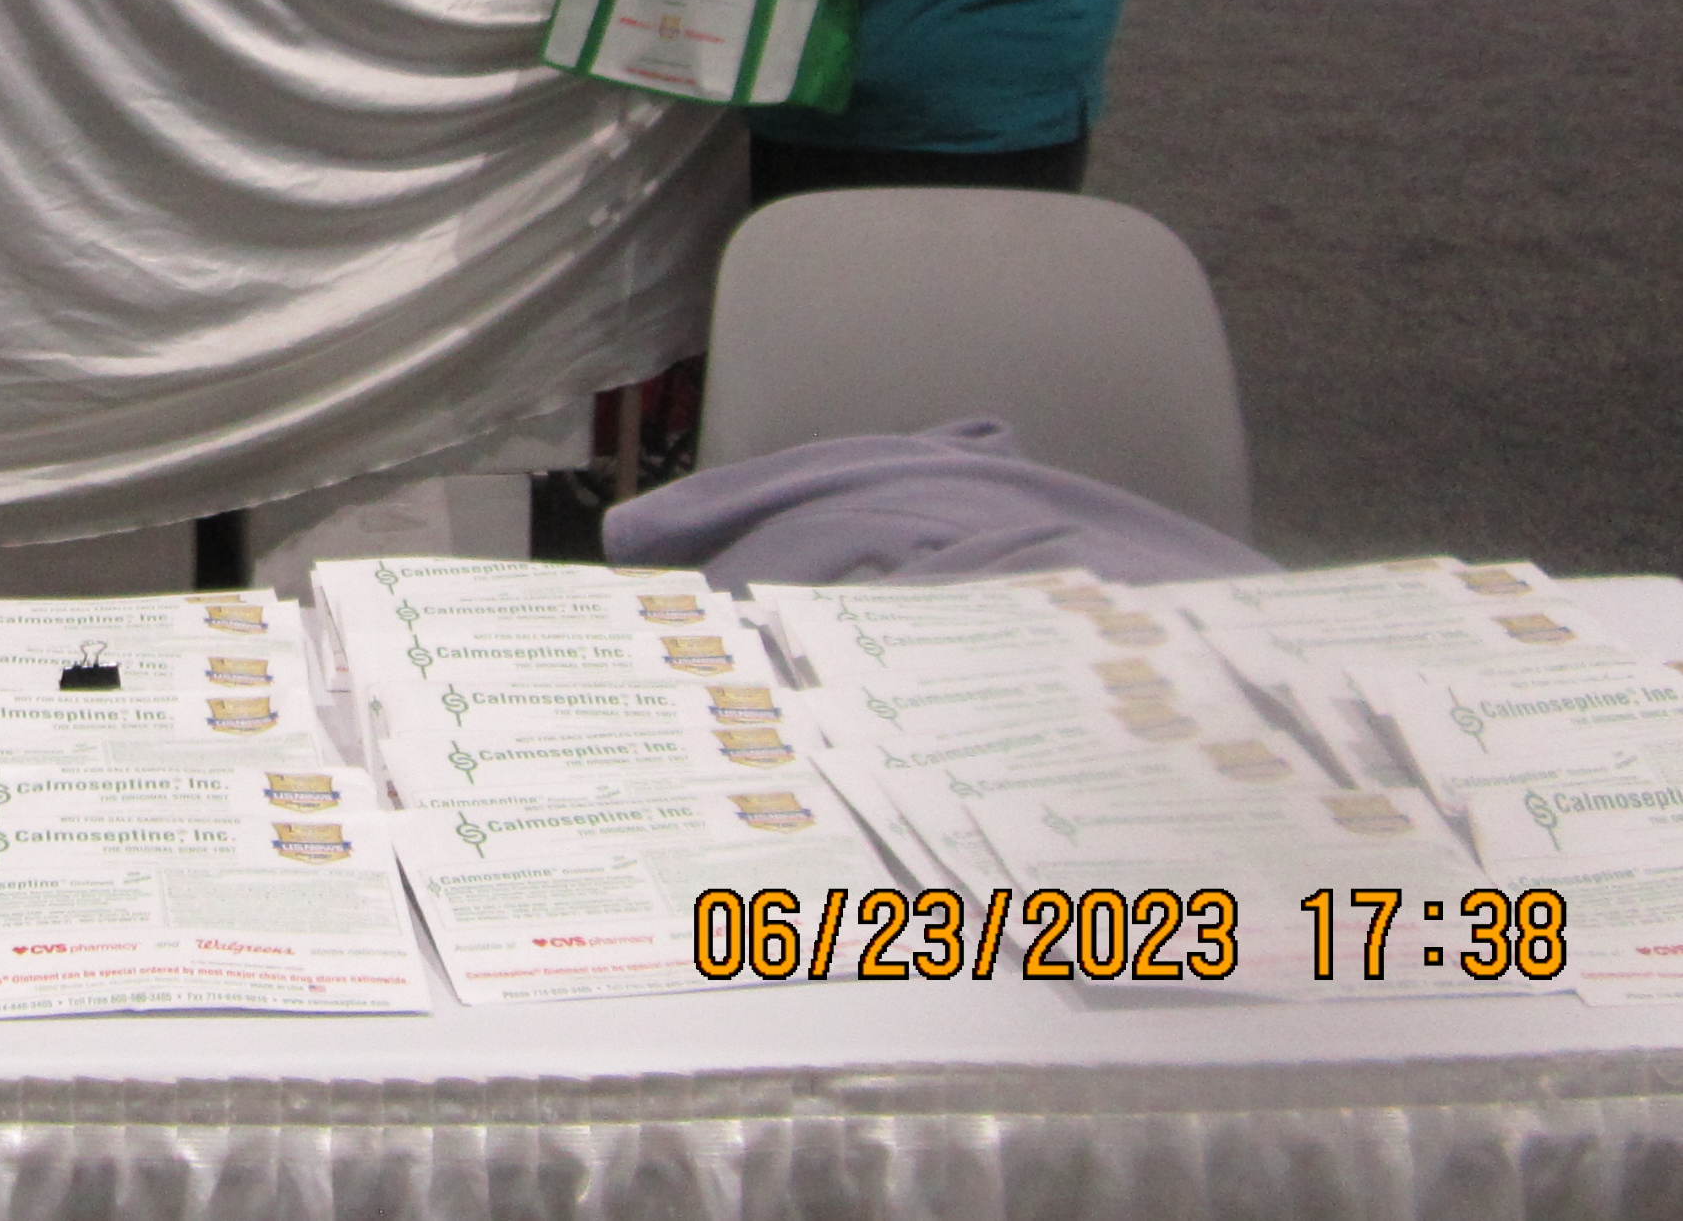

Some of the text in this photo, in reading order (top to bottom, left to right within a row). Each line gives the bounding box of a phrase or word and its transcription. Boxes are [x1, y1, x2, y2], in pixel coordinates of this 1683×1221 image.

[29, 938, 296, 956] CVS pharmacy Walgreens
[549, 934, 655, 949] CVS pharmacy
